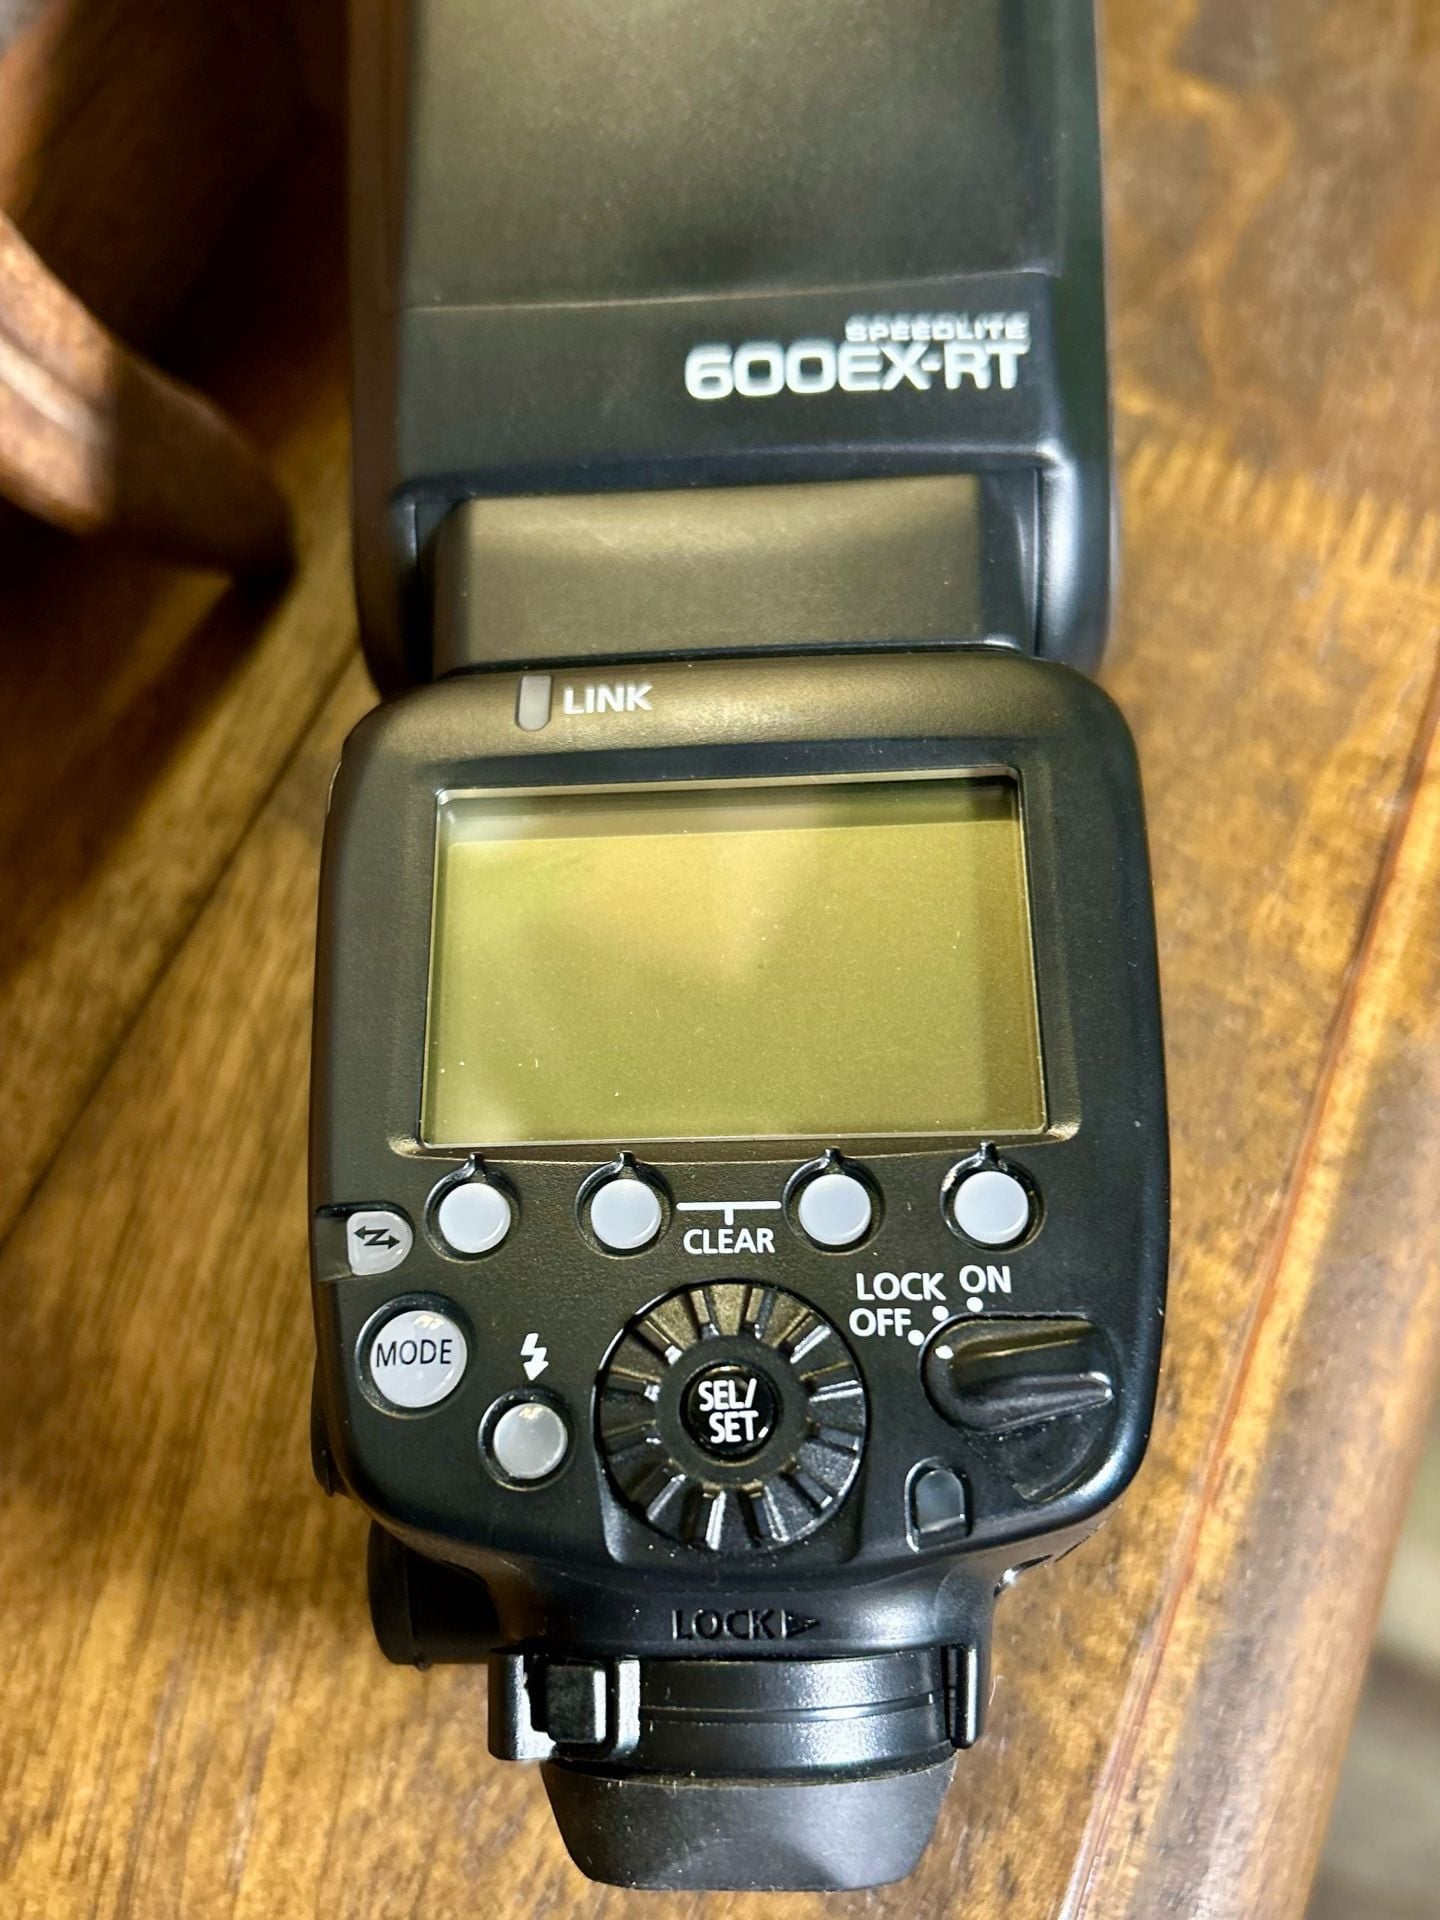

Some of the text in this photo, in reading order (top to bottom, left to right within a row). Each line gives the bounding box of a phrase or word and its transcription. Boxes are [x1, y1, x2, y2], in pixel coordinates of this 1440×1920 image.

[845, 312, 1029, 341] SPEEDLITE
[685, 339, 1031, 399] 600EX-RT
[563, 683, 653, 714] LINK
[682, 1227, 775, 1254] CLEAR
[856, 1272, 946, 1301] LOCK
[958, 1265, 1011, 1294] ON
[849, 1308, 911, 1336] OFF
[376, 1339, 453, 1368] MODE
[698, 1378, 757, 1411] SEL/
[709, 1410, 759, 1444] SET
[671, 1609, 777, 1640] LOCK
